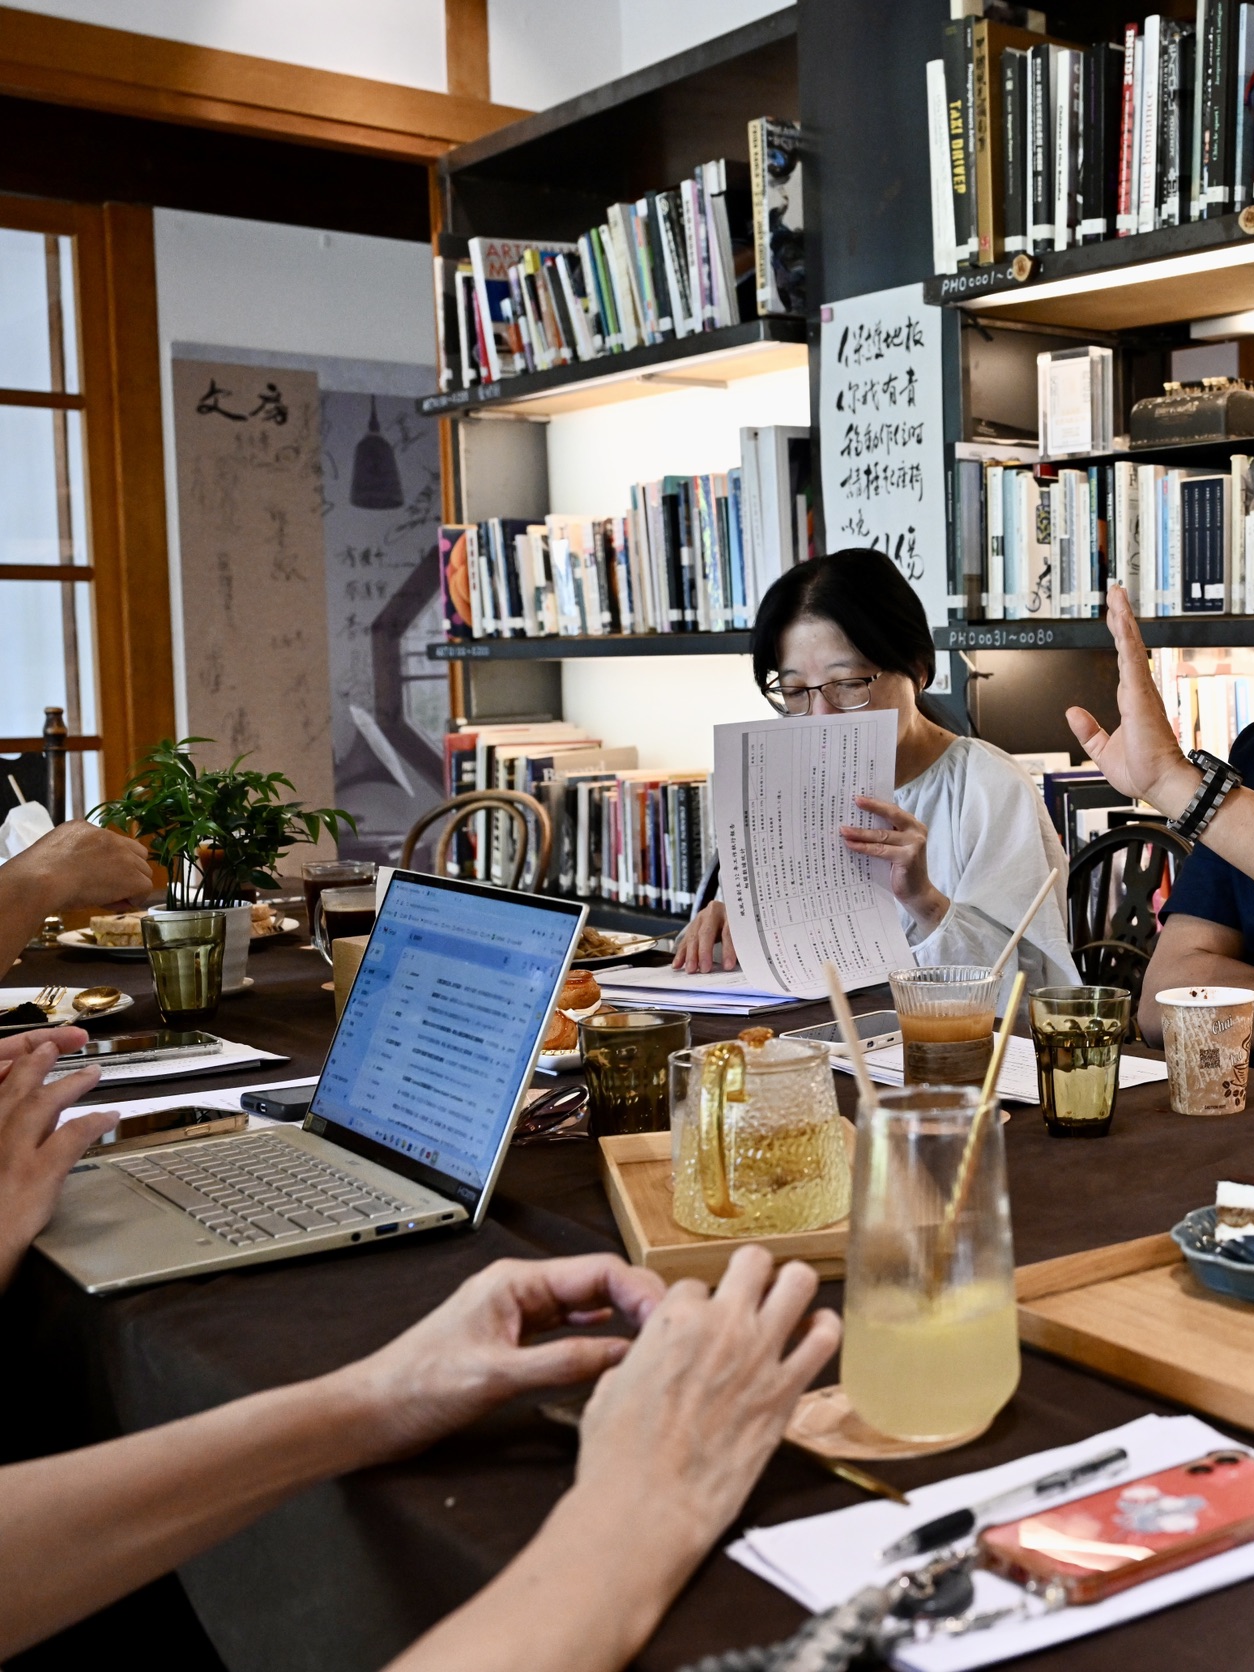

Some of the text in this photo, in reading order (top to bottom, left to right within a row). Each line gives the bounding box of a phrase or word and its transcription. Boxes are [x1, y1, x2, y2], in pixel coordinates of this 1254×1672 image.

[1125, 29, 1135, 86] INSIDE
[949, 99, 964, 134] TAXI
[1143, 91, 1154, 166] Romance
[836, 316, 926, 368] 保護地板
[836, 366, 919, 415] 你我有責
